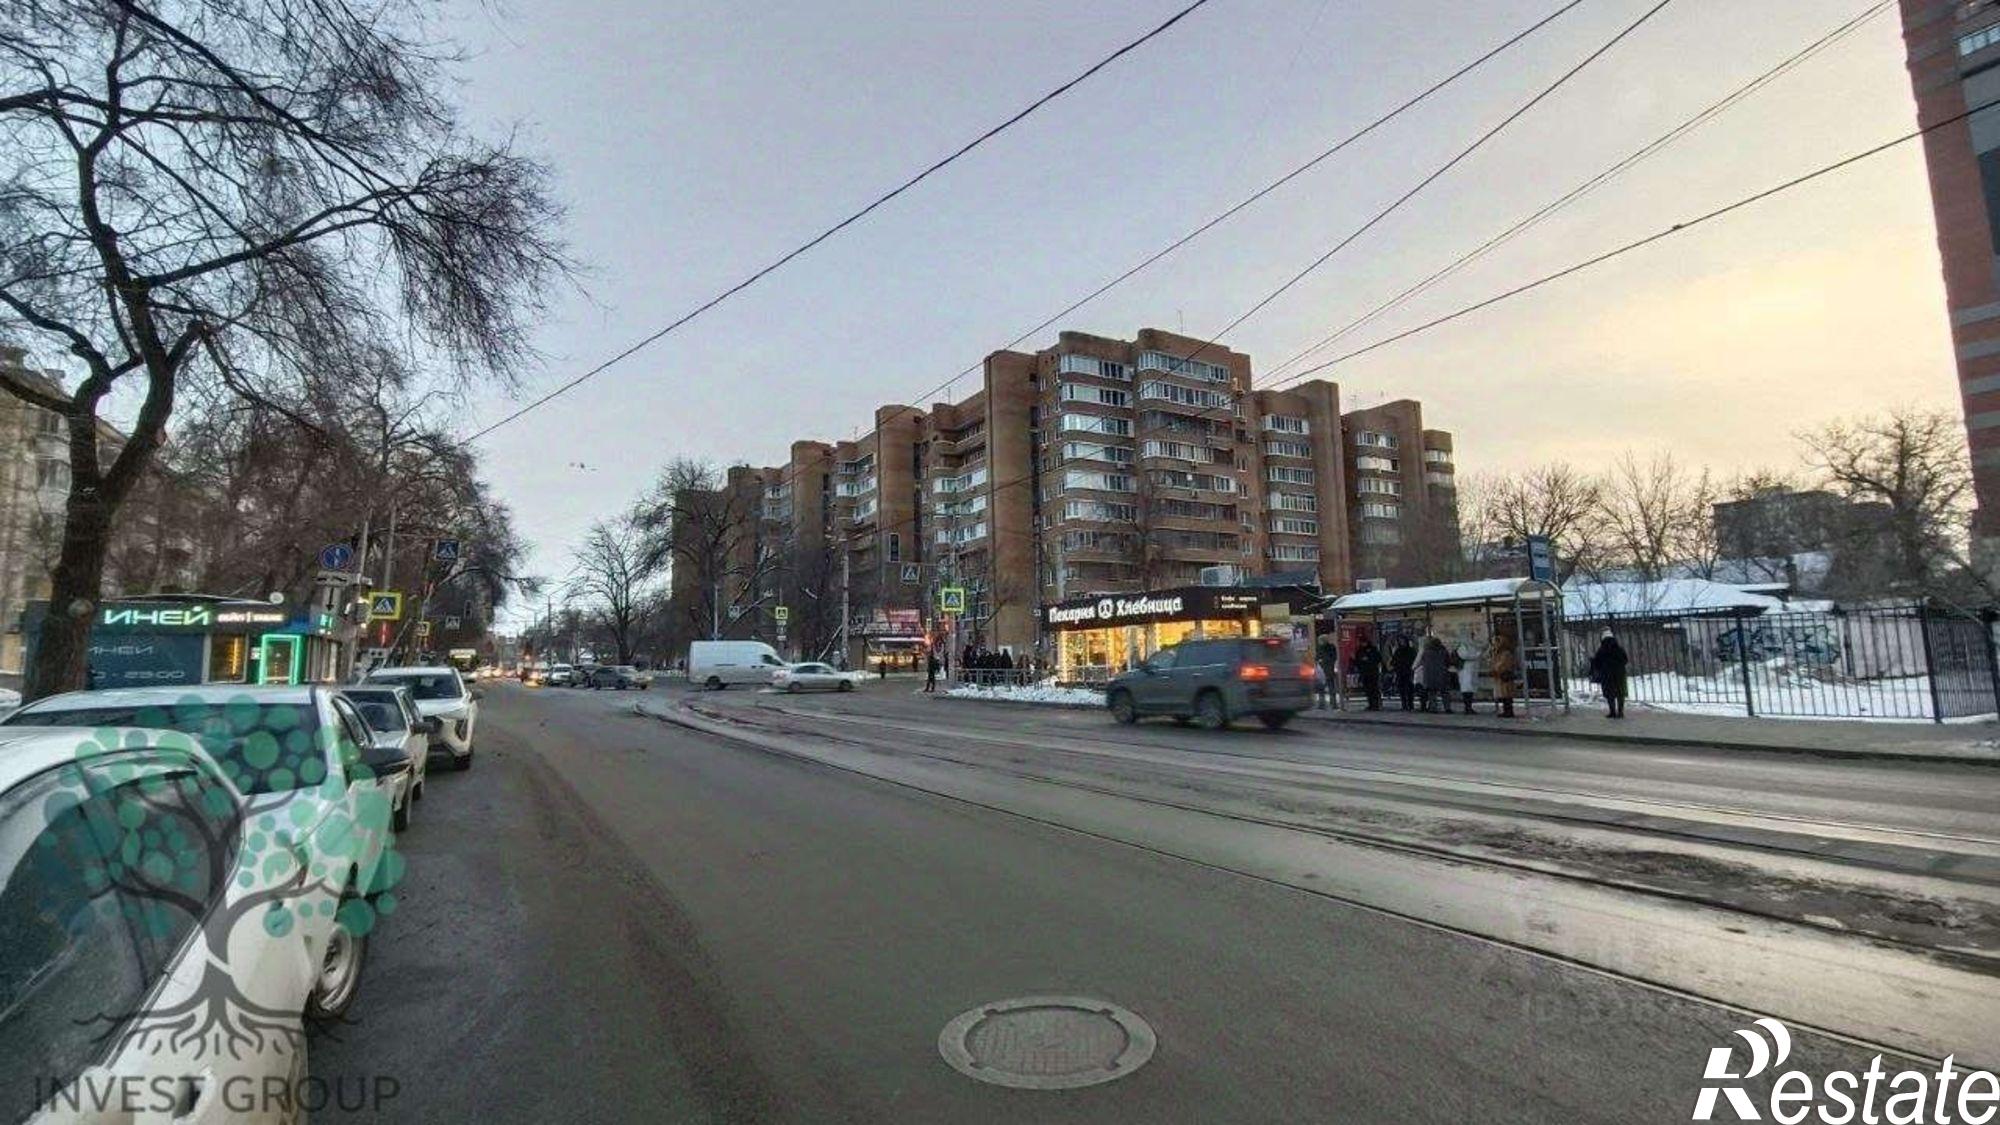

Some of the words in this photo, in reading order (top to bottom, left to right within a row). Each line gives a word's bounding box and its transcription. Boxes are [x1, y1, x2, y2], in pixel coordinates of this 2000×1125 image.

[104, 605, 210, 626] ИНЕЙ
[1049, 606, 1095, 624] Пекарня
[1116, 596, 1183, 617] Хлебница
